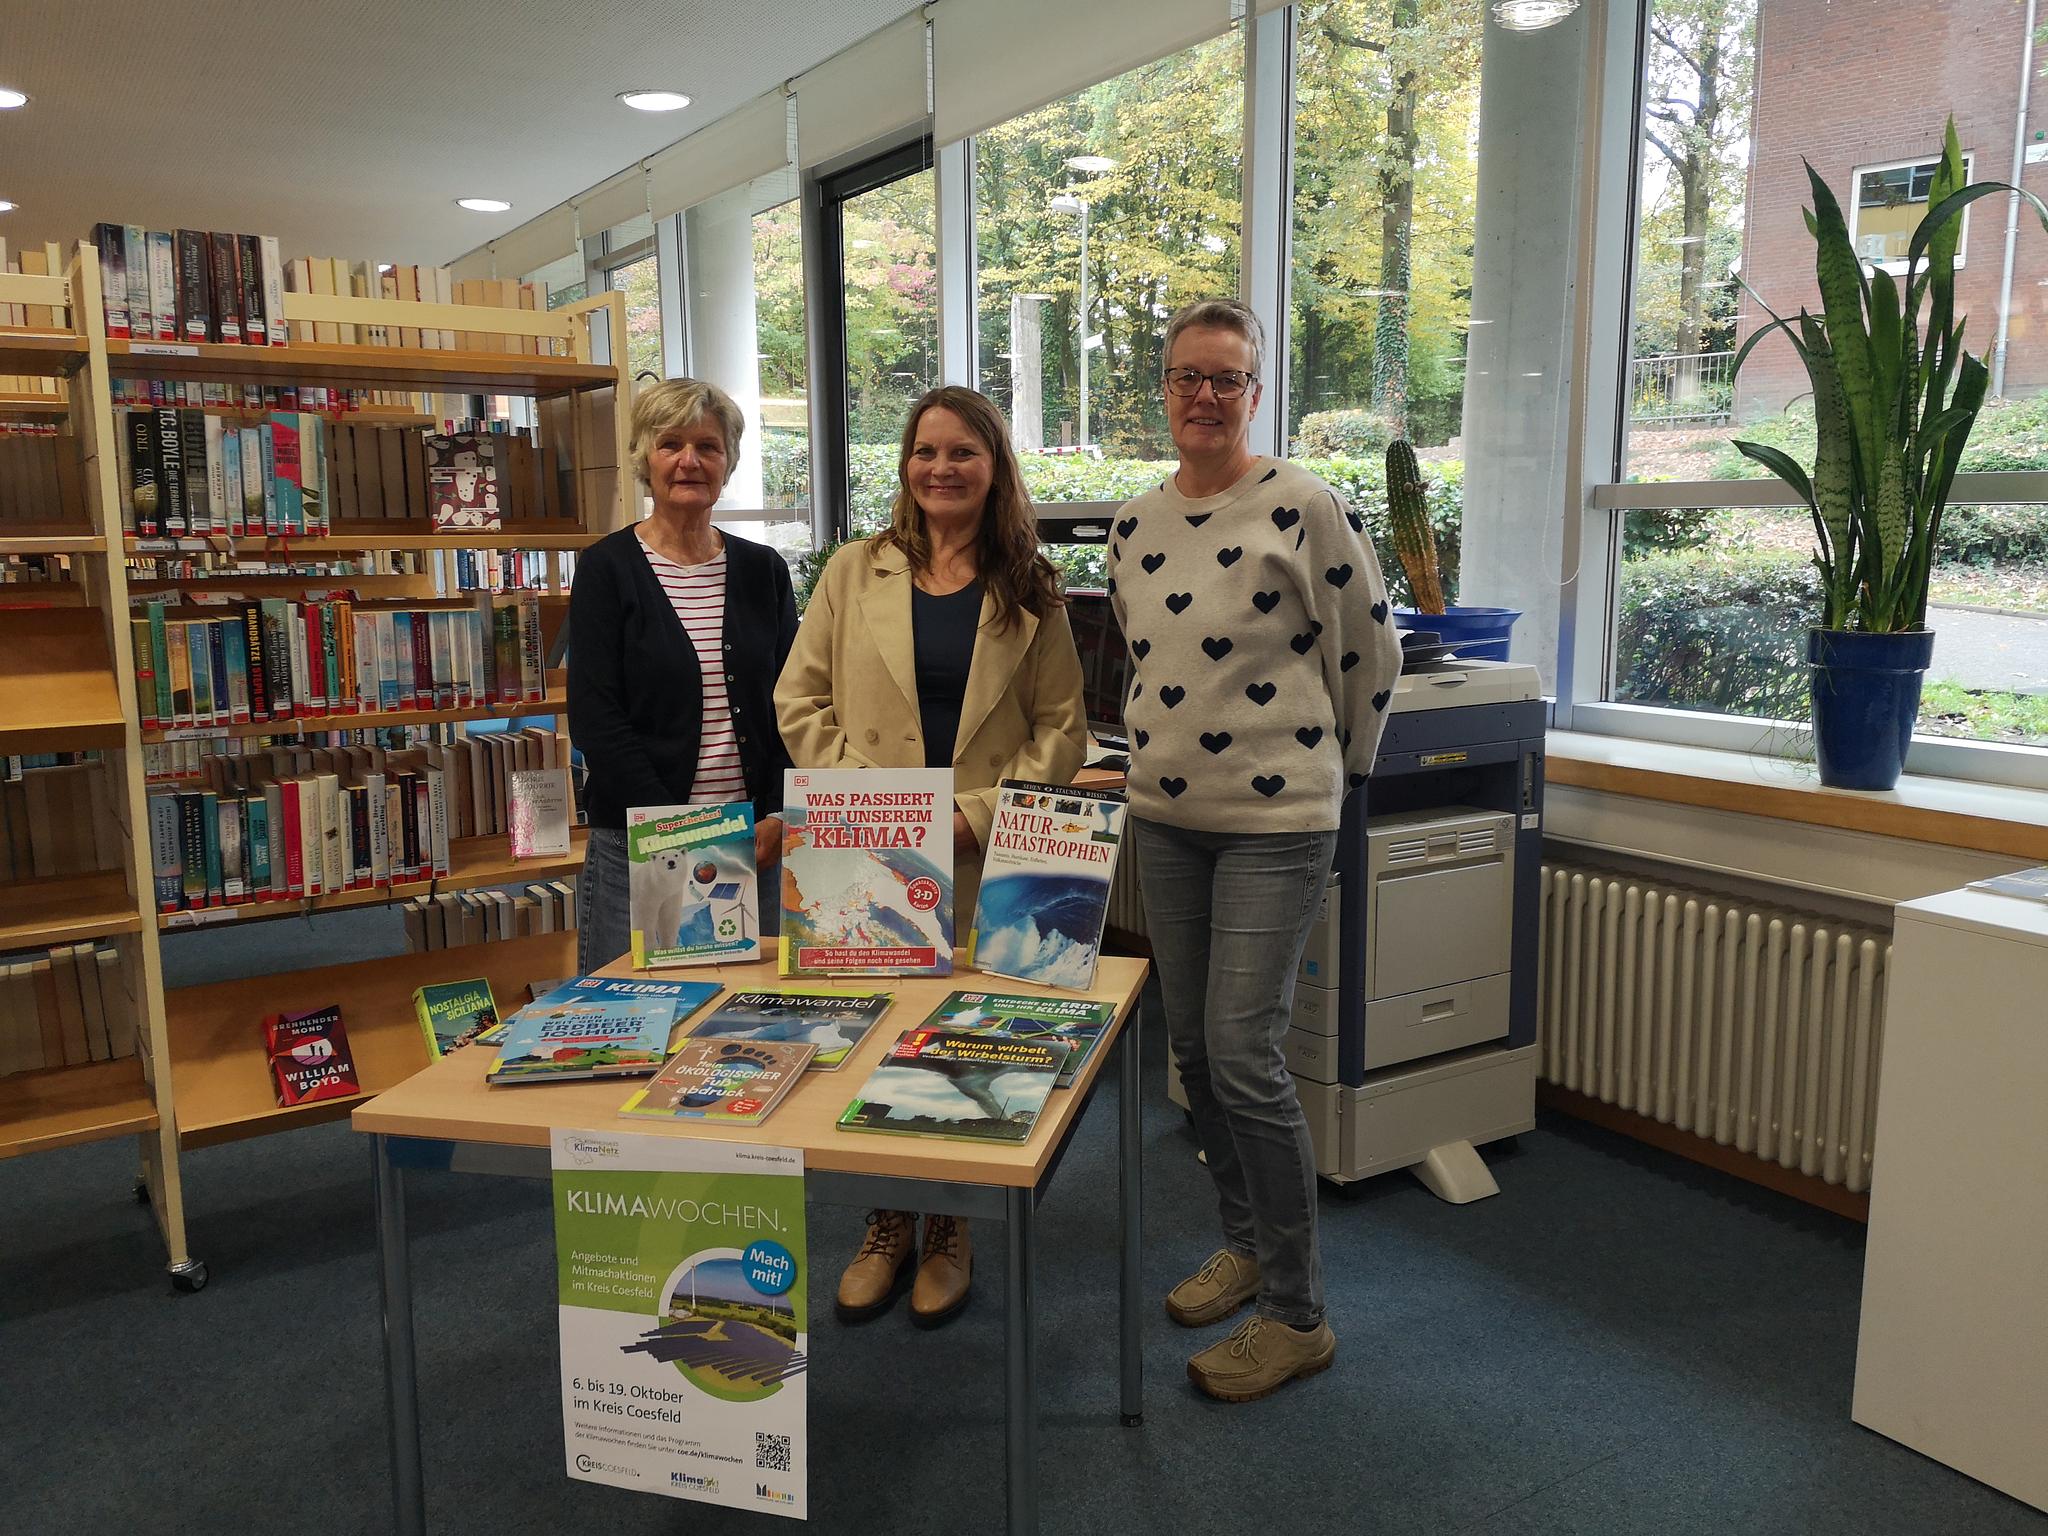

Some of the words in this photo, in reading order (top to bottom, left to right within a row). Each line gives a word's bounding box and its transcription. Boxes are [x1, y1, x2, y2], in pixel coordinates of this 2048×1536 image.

[159, 409, 178, 430] T.C.
[136, 423, 148, 452] TRIO
[161, 431, 180, 469] BOYLE
[143, 468, 155, 501] BOYD
[168, 470, 178, 482] DIE
[246, 608, 260, 662] BRANDSÄTZE
[272, 656, 280, 684] Michael
[252, 668, 263, 694] STEPH
[806, 793, 844, 806] WAS
[850, 792, 934, 806] PASSIERT
[1023, 784, 1041, 792] SEHEN
[1055, 788, 1082, 796] STAUNEN
[1085, 792, 1108, 800] WISSEN
[656, 810, 722, 831] Superchecker!
[808, 810, 842, 823] MIT
[846, 810, 932, 822] UNSEREM
[998, 810, 1058, 835] NATUR-
[637, 814, 748, 854] Klimawandel
[812, 826, 926, 848] KLIMA?
[994, 831, 1110, 864] KATASTROPHEN
[913, 888, 933, 902] 3-D
[668, 946, 685, 954] willst
[846, 958, 866, 966] Folgen
[895, 957, 921, 966] gesehen
[605, 983, 682, 994] KLIMA
[430, 990, 482, 1016] NOSTALGIA
[446, 998, 492, 1022] SICILIANA
[735, 994, 876, 1009] Klimawandel
[992, 998, 1040, 1006] ENTDECKE
[1060, 1002, 1102, 1010] ERDE
[1035, 1006, 1088, 1016] KLIMA
[272, 1015, 339, 1031] BRENNENDER
[292, 1024, 324, 1035] MOND
[538, 1026, 645, 1038] JOGHURT
[912, 1033, 926, 1046] !
[928, 1047, 954, 1056] der
[958, 1050, 1052, 1064] Wirbelsturm?
[946, 1040, 994, 1050] Warum
[998, 1044, 1048, 1055] wirbelt
[675, 1065, 782, 1080] ÖKOLOGISCHER
[696, 1060, 723, 1068] Mein
[286, 1064, 350, 1082] WILLIAM
[300, 1076, 342, 1090] BOYD
[676, 1086, 746, 1098] abdruck
[574, 1143, 620, 1155] KlimaNetz
[736, 1152, 796, 1164] klima.kreis-coesfeld.de
[568, 1190, 788, 1232] KLIMAWOCHEN.
[571, 1250, 618, 1265] Angebote
[620, 1254, 639, 1266] und
[750, 1248, 790, 1271] Mach
[572, 1266, 656, 1284] Mitmachaktionen
[752, 1268, 782, 1287] mit!
[572, 1280, 585, 1290] im
[587, 1282, 610, 1294] Kreis
[612, 1285, 656, 1300] Coesfeld.
[573, 1378, 584, 1390] 6.
[588, 1379, 605, 1393] bis
[608, 1383, 627, 1397] 19.
[630, 1385, 684, 1404] Oktober
[574, 1396, 590, 1410] im
[594, 1399, 623, 1415] Kreis
[627, 1404, 681, 1424] Coesfeld
[574, 1421, 598, 1432] Weitere
[599, 1425, 642, 1439] Informationen
[643, 1431, 656, 1441] und
[656, 1433, 668, 1443] das
[668, 1435, 701, 1447] Programm
[586, 1432, 627, 1446] Klimawochen
[628, 1438, 647, 1450] finden
[678, 1447, 744, 1464] coe.de/klimawochen
